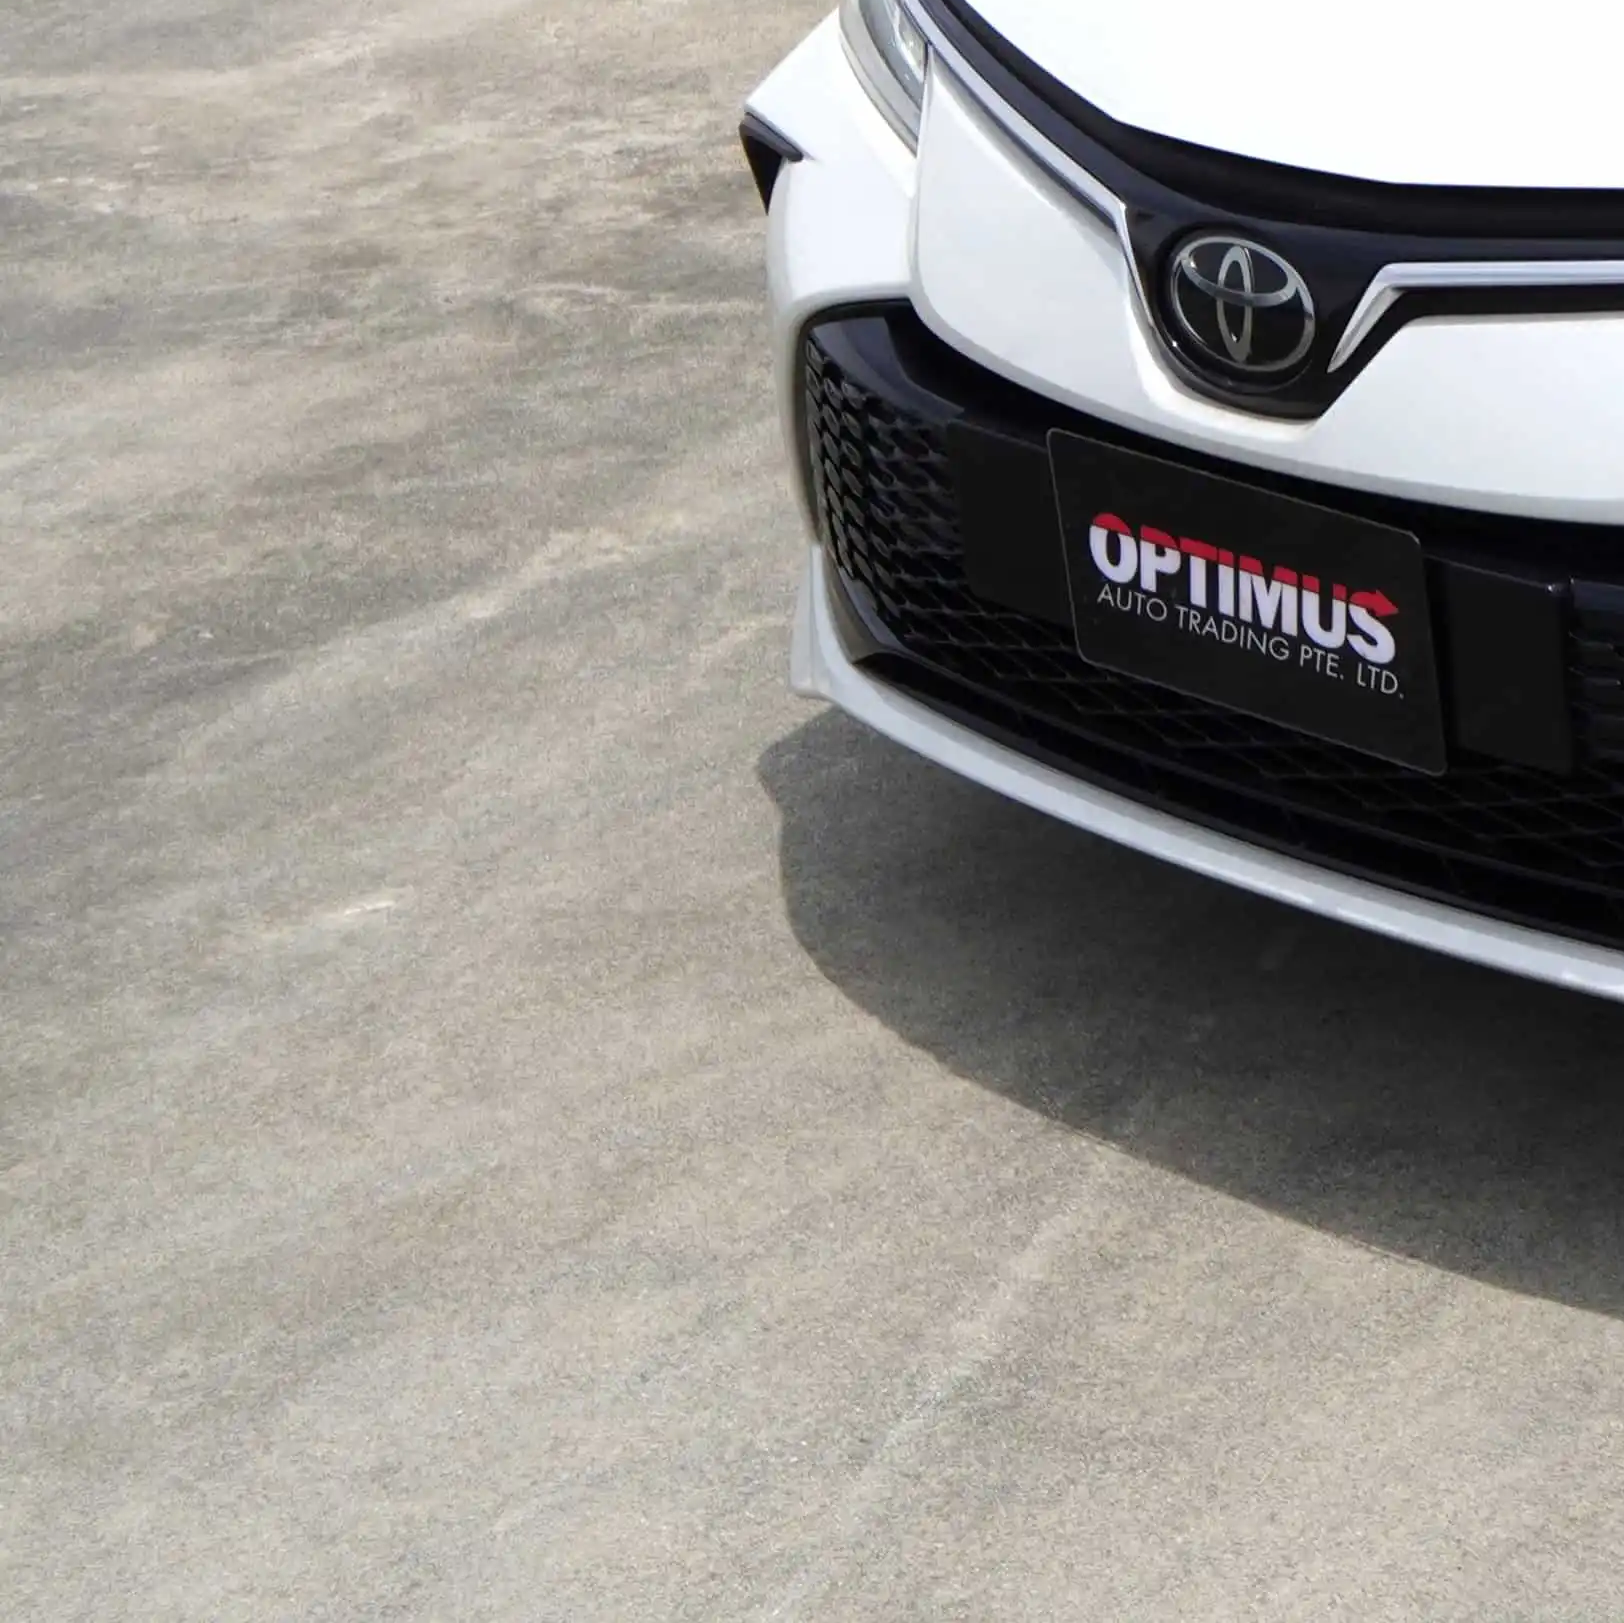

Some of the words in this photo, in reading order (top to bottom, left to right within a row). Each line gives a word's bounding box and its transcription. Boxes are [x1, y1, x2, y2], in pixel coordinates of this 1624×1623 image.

[1088, 512, 1399, 665] OPTIMUS
[1096, 583, 1168, 622] AUTO
[1175, 605, 1290, 661] TRADING
[1300, 645, 1345, 681] PTE.
[1357, 663, 1405, 699] LTD.
